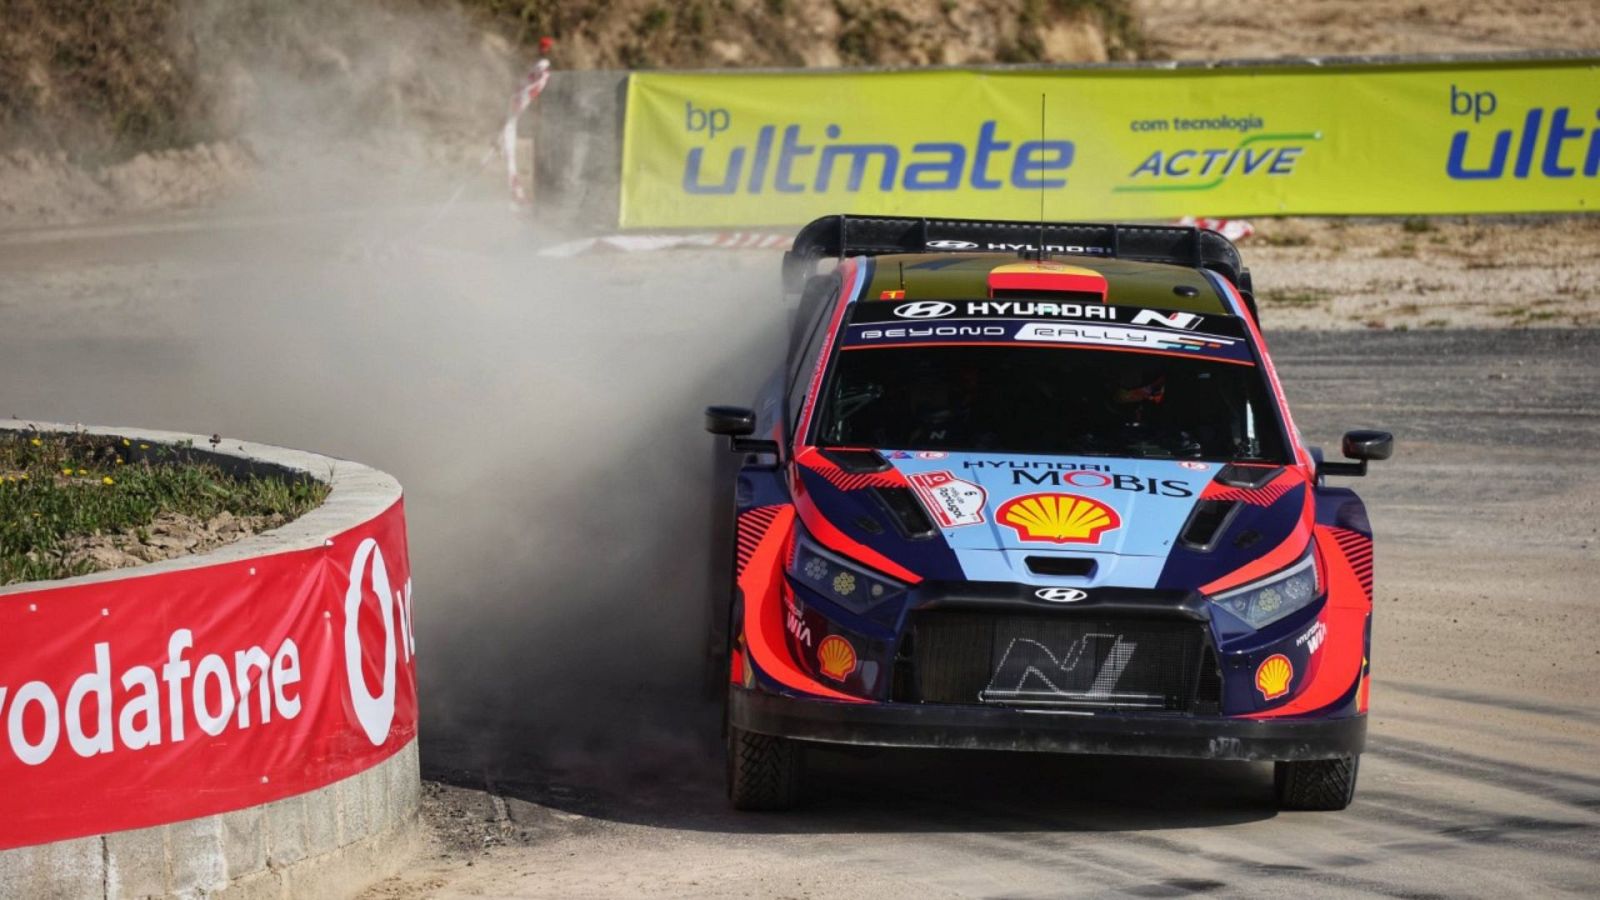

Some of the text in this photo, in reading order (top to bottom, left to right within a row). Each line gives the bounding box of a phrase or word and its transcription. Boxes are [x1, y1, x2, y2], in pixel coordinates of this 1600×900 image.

[1450, 84, 1497, 122] bp
[685, 101, 730, 138] bp
[1130, 114, 1264, 134] com tecnologia
[681, 120, 1076, 195] ultimate
[1129, 146, 1304, 178] ACTIVE
[966, 301, 1116, 320] HYUNDAI
[860, 326, 1147, 343] BEYOND RALLY
[963, 460, 1111, 472] HYUNDAI
[1012, 469, 1193, 499] MOBIS
[0, 628, 302, 766] odafone
